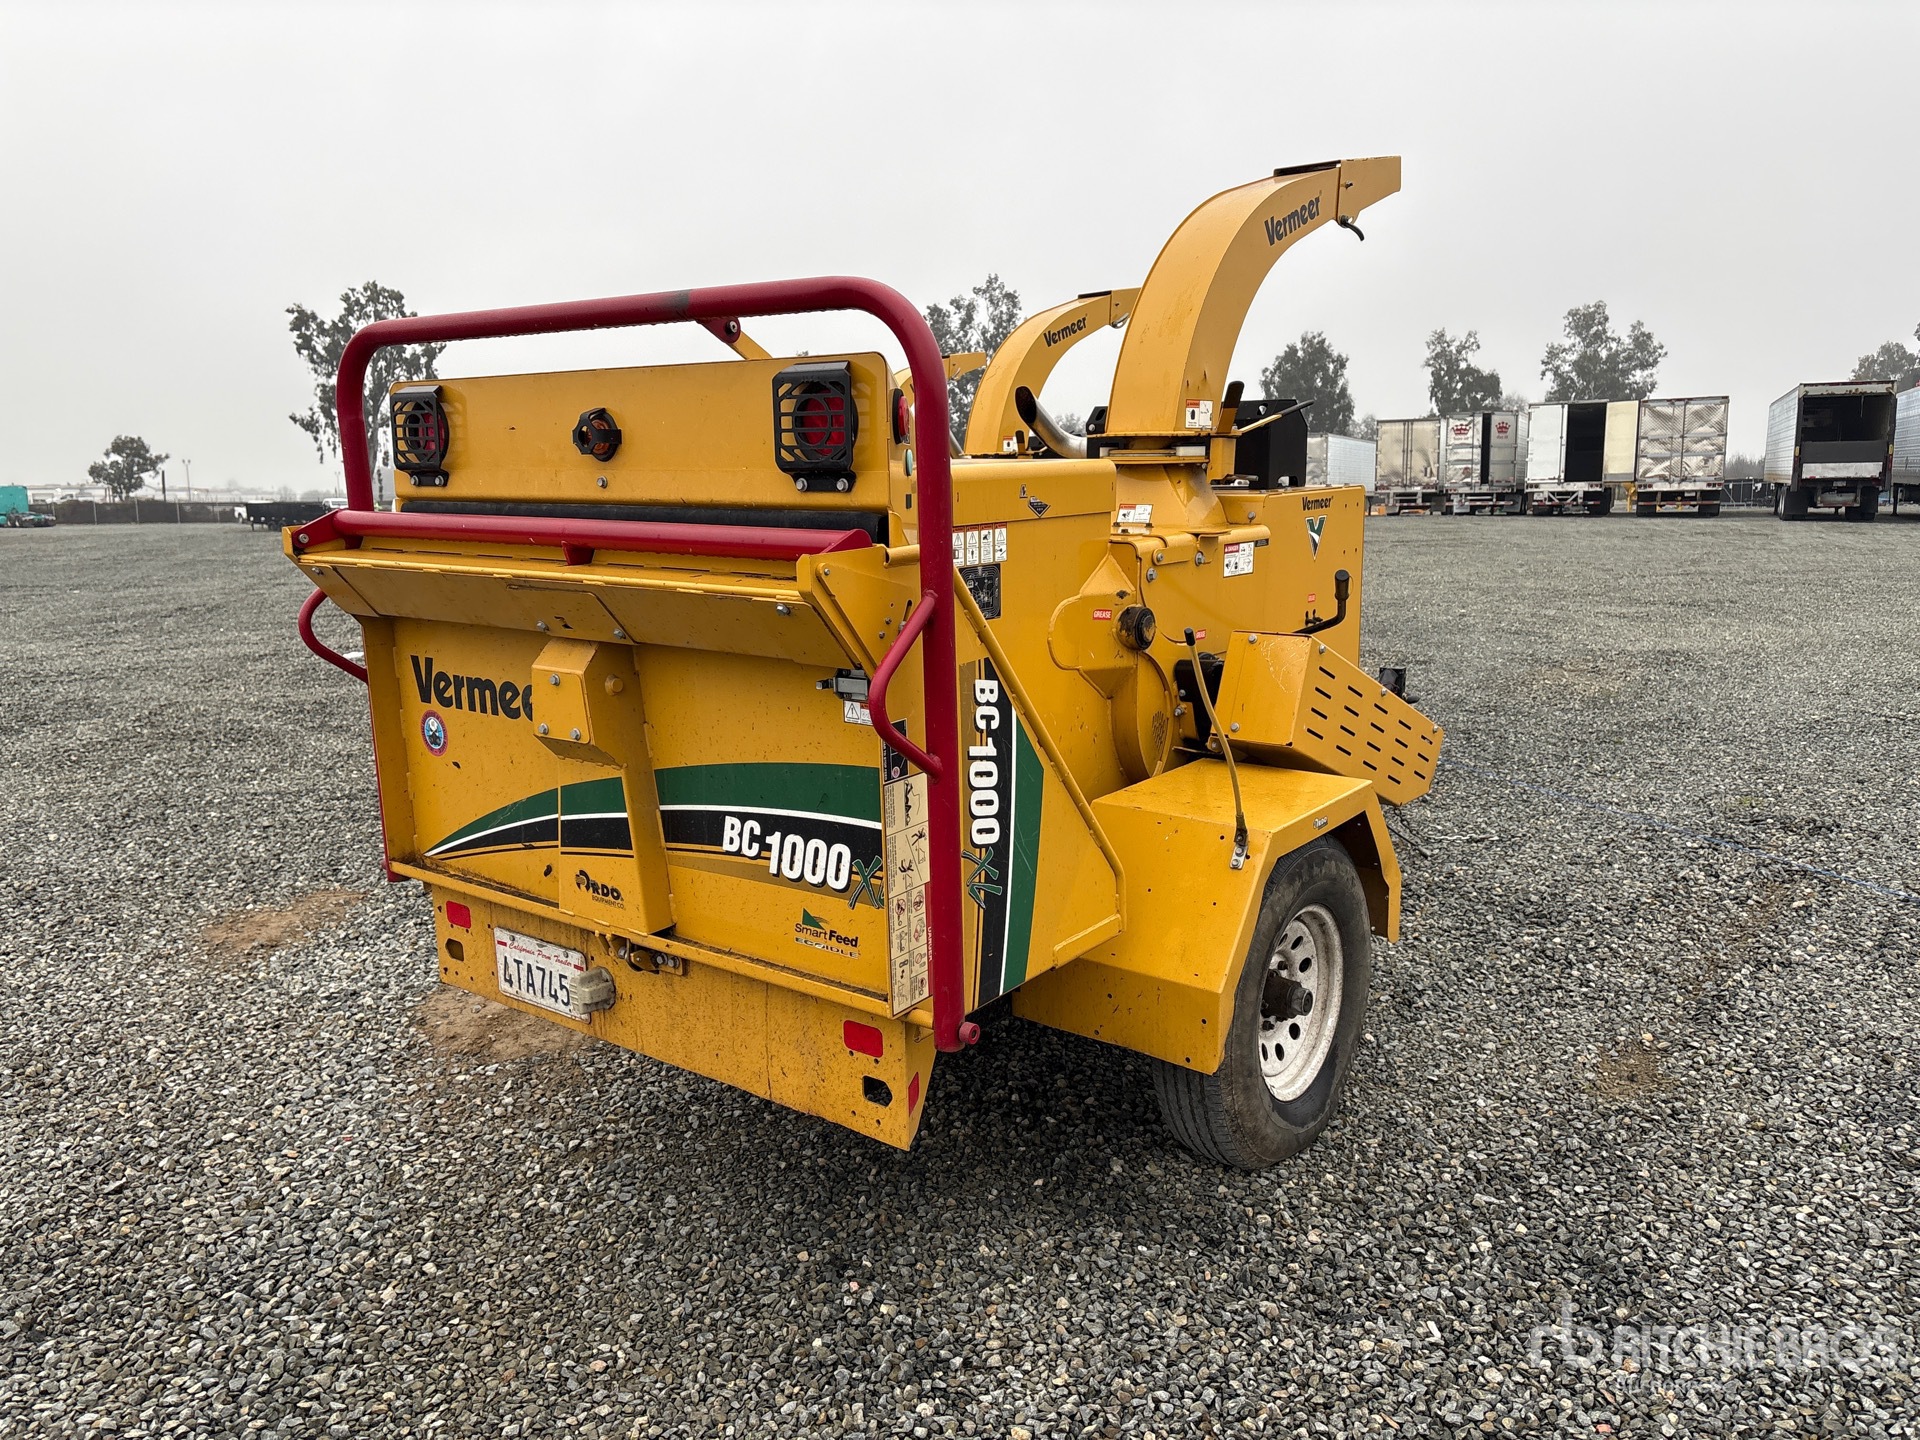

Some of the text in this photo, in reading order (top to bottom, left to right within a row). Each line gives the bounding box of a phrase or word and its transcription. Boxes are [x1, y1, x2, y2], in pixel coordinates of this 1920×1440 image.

[1264, 196, 1320, 247] Vermeer
[1043, 316, 1087, 347] Vermeer
[1302, 496, 1332, 511] Vermeer
[1093, 610, 1112, 619] GREASE
[509, 941, 572, 967] California Perm Trailer
[503, 955, 570, 1007] 4TA745
